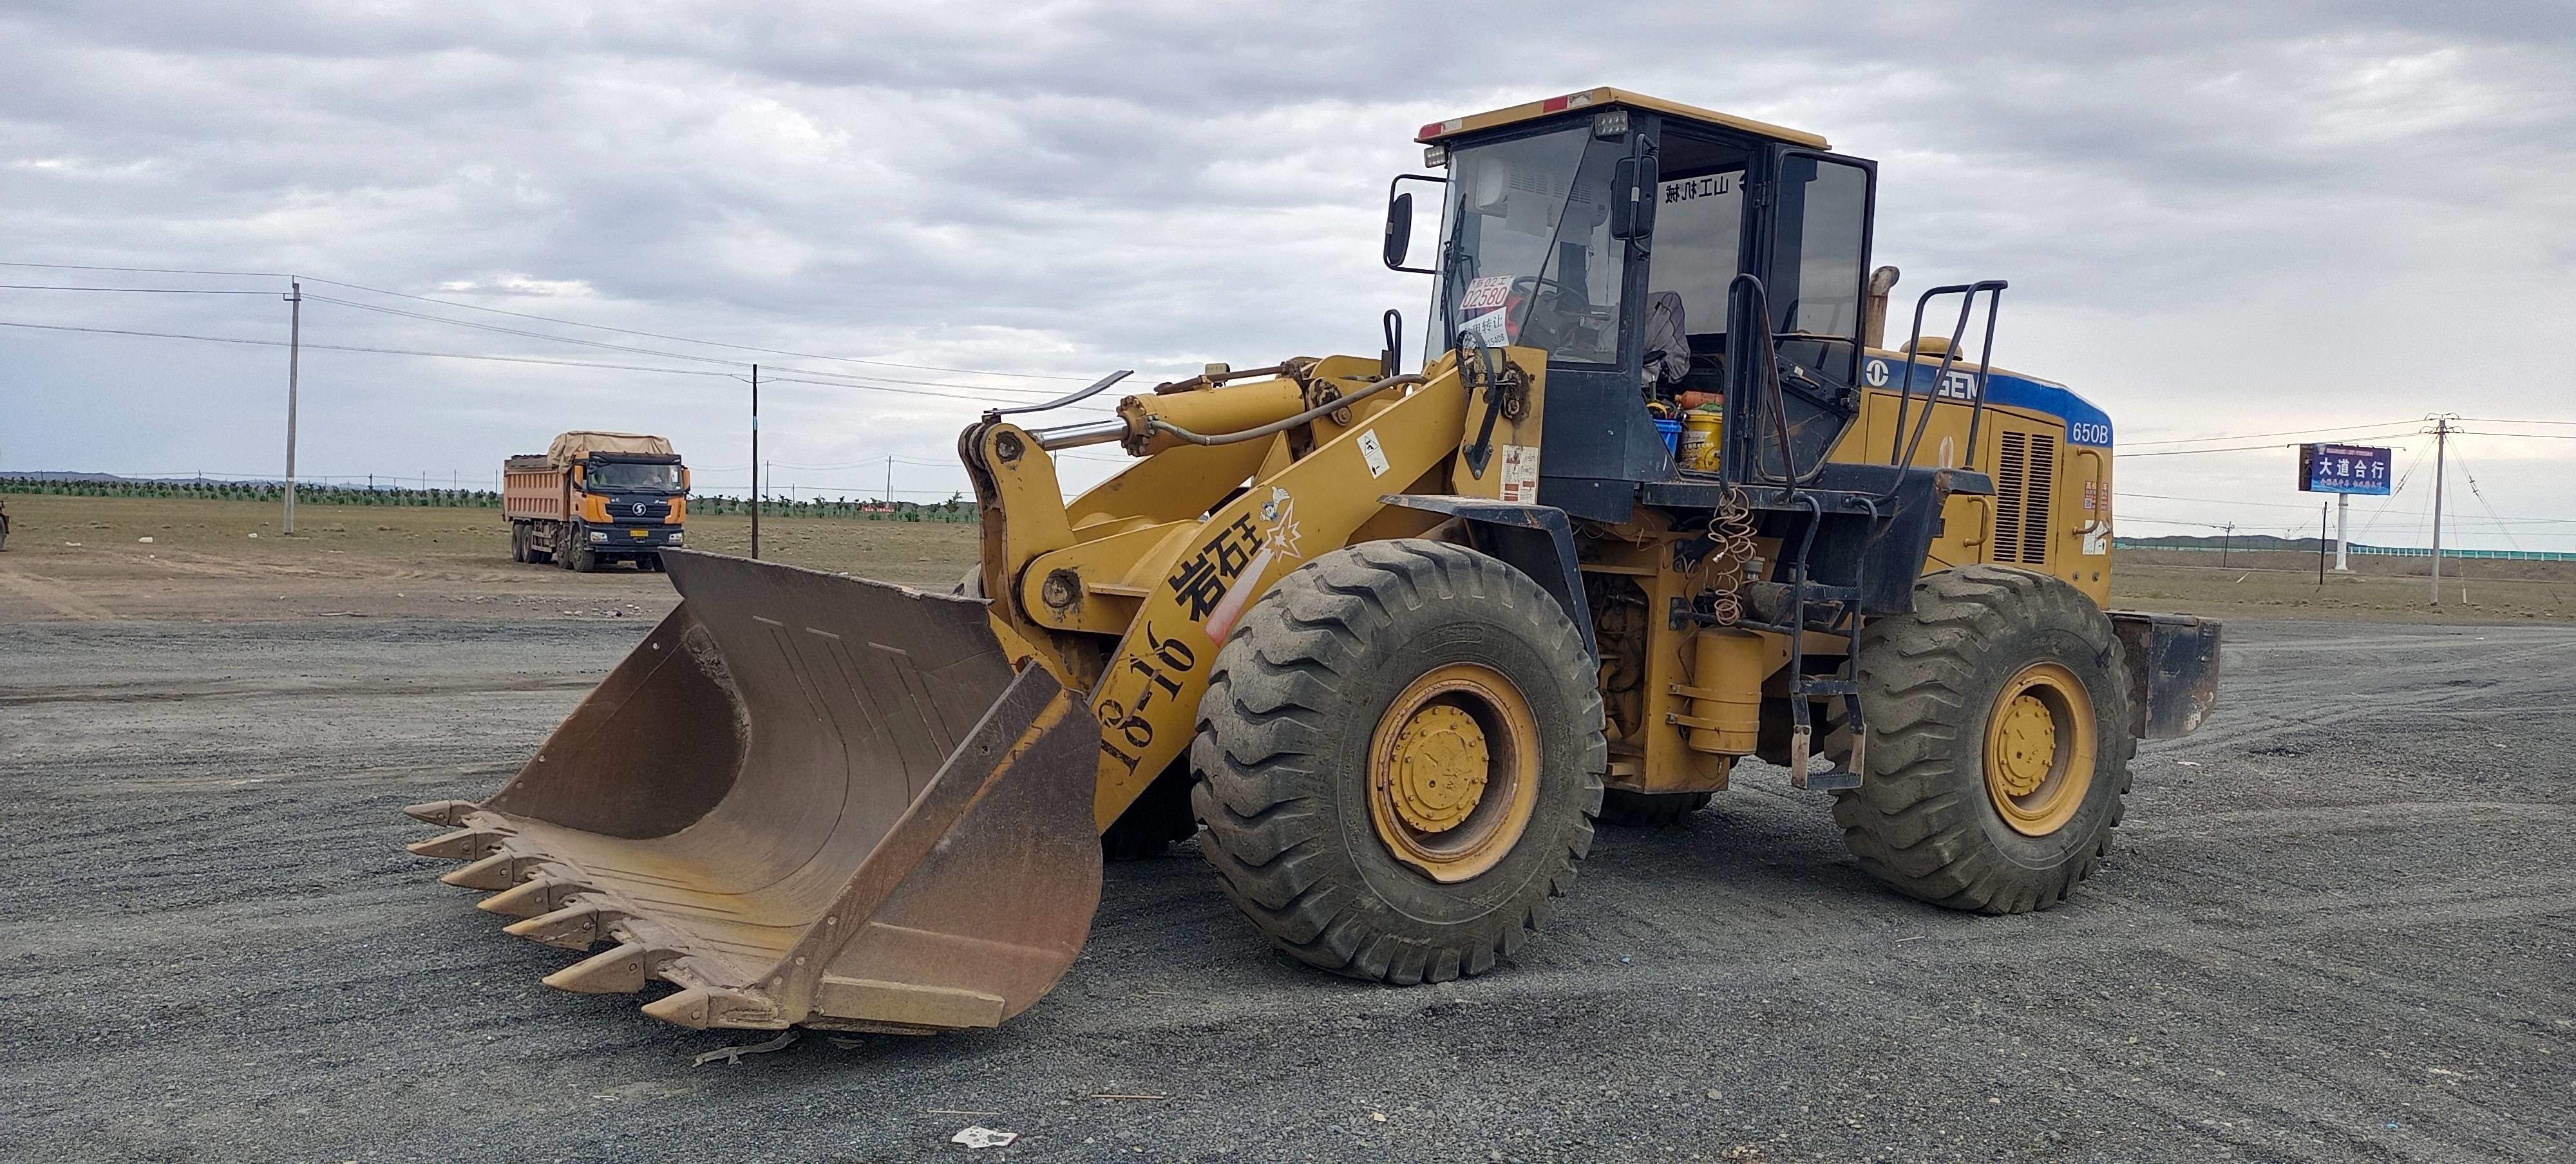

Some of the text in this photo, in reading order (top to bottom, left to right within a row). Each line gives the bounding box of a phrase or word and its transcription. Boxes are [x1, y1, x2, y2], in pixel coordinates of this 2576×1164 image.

[1463, 287, 1508, 308] 02580
[2073, 422, 2108, 444] 650B
[2319, 457, 2385, 479] 大道合行
[1168, 511, 1264, 623] 岩石王
